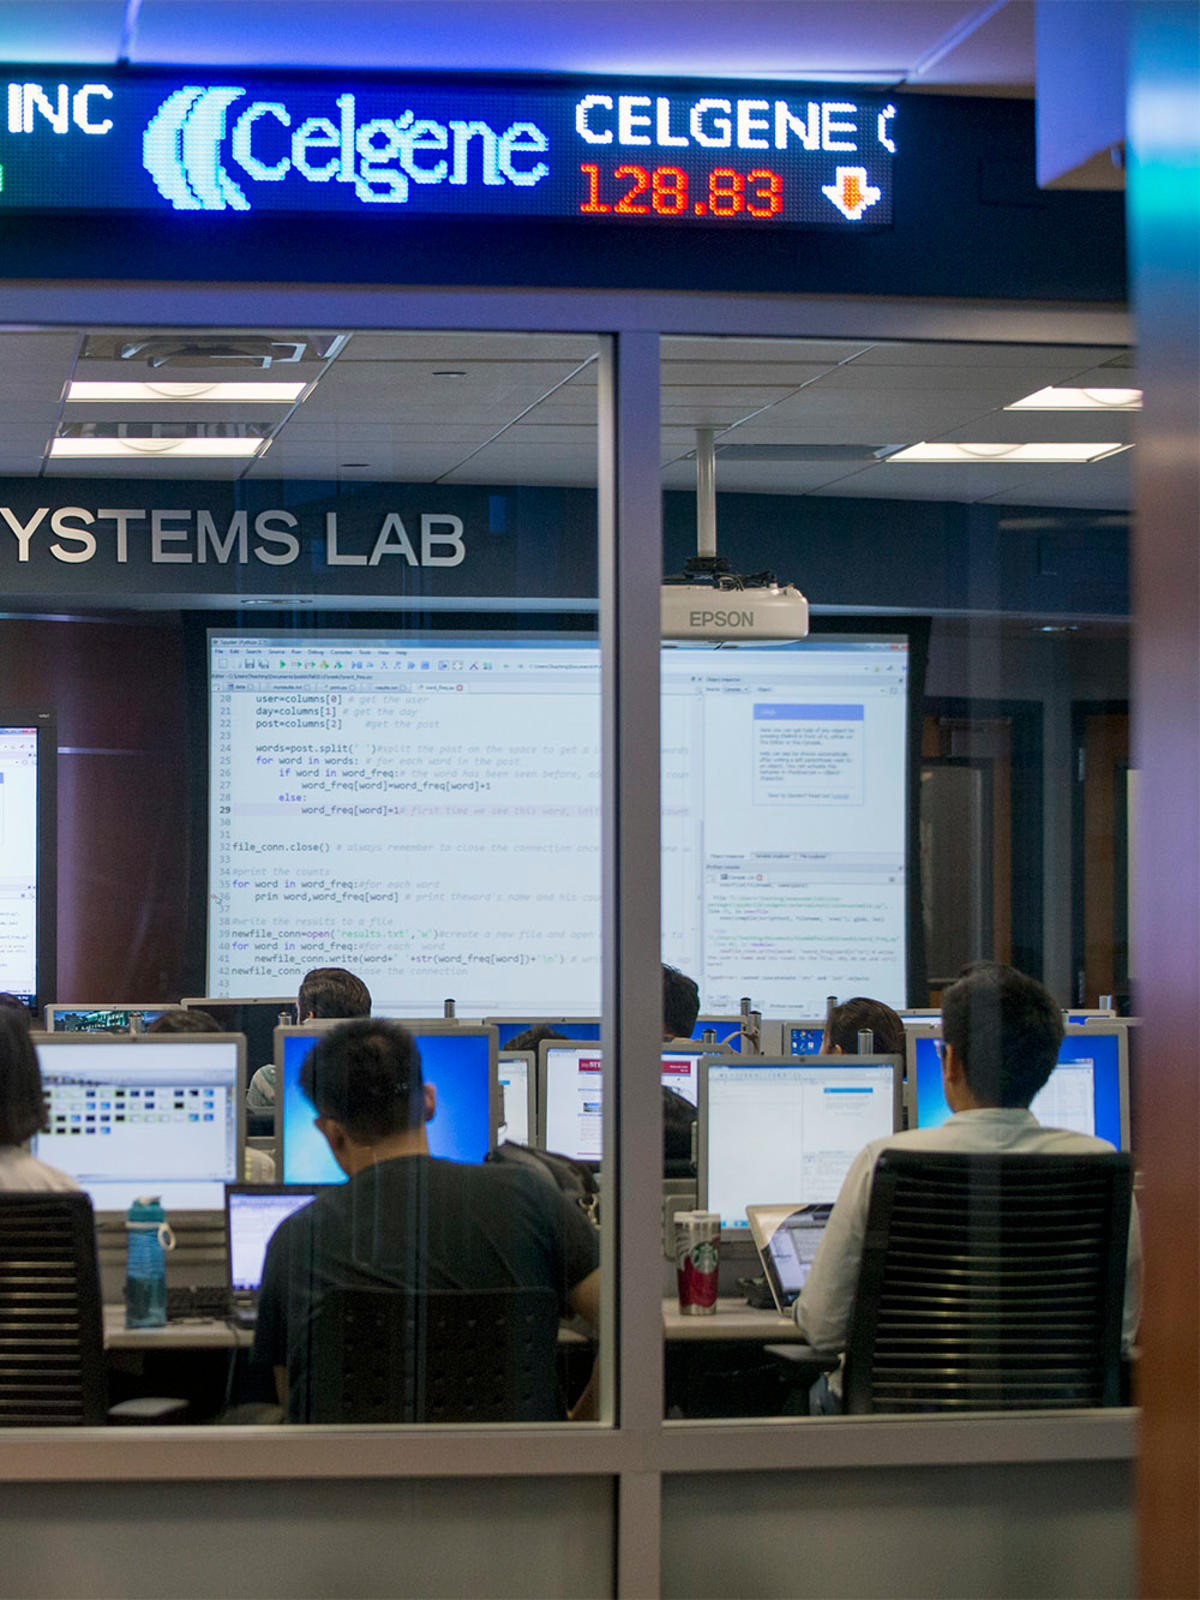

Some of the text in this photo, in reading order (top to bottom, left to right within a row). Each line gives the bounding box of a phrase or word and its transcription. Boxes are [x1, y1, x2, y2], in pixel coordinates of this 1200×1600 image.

[7, 82, 114, 134] INC
[575, 93, 859, 152] CELGENE
[232, 93, 551, 204] Celgene
[578, 163, 783, 218] 128.83
[326, 511, 467, 568] LAB
[689, 610, 754, 627] EPSON
